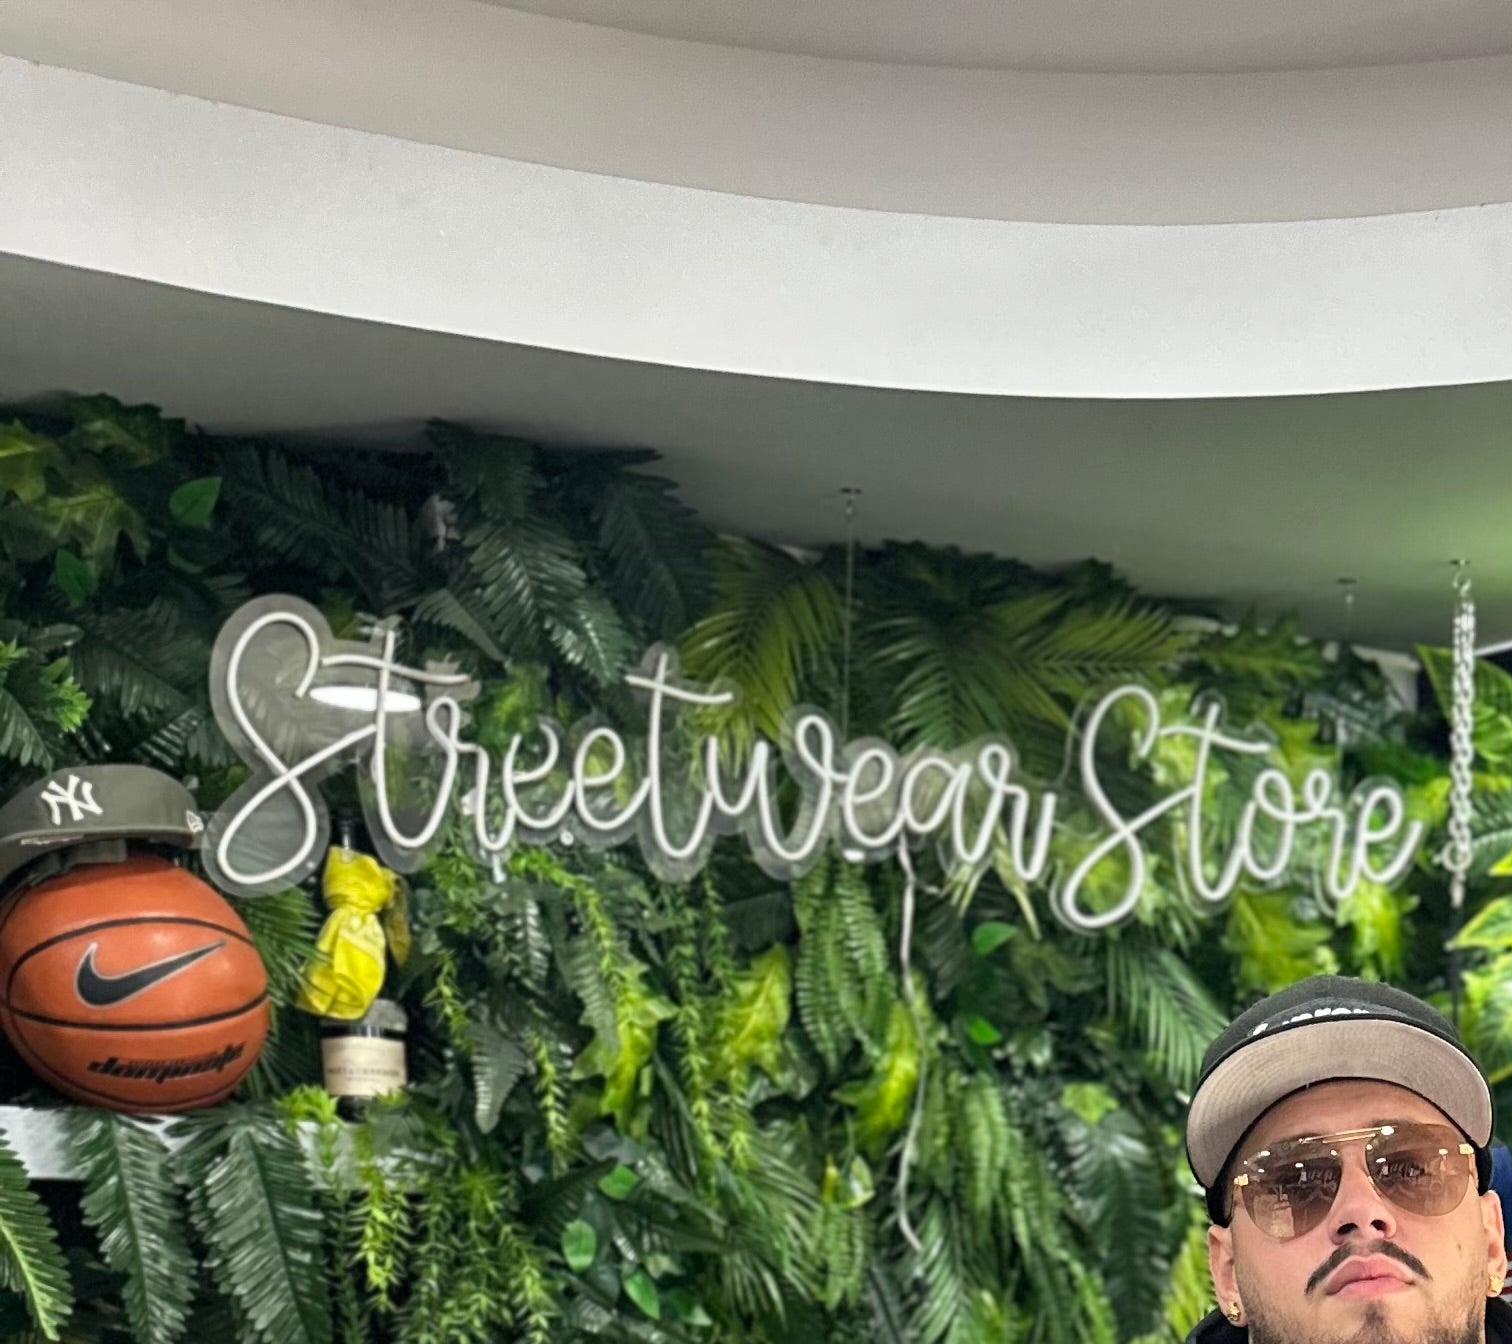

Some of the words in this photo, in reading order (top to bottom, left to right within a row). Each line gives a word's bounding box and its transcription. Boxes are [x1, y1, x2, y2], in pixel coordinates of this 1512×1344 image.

[41, 774, 103, 826] NY
[216, 611, 1056, 885] Streetwear
[1062, 685, 1423, 930] Store
